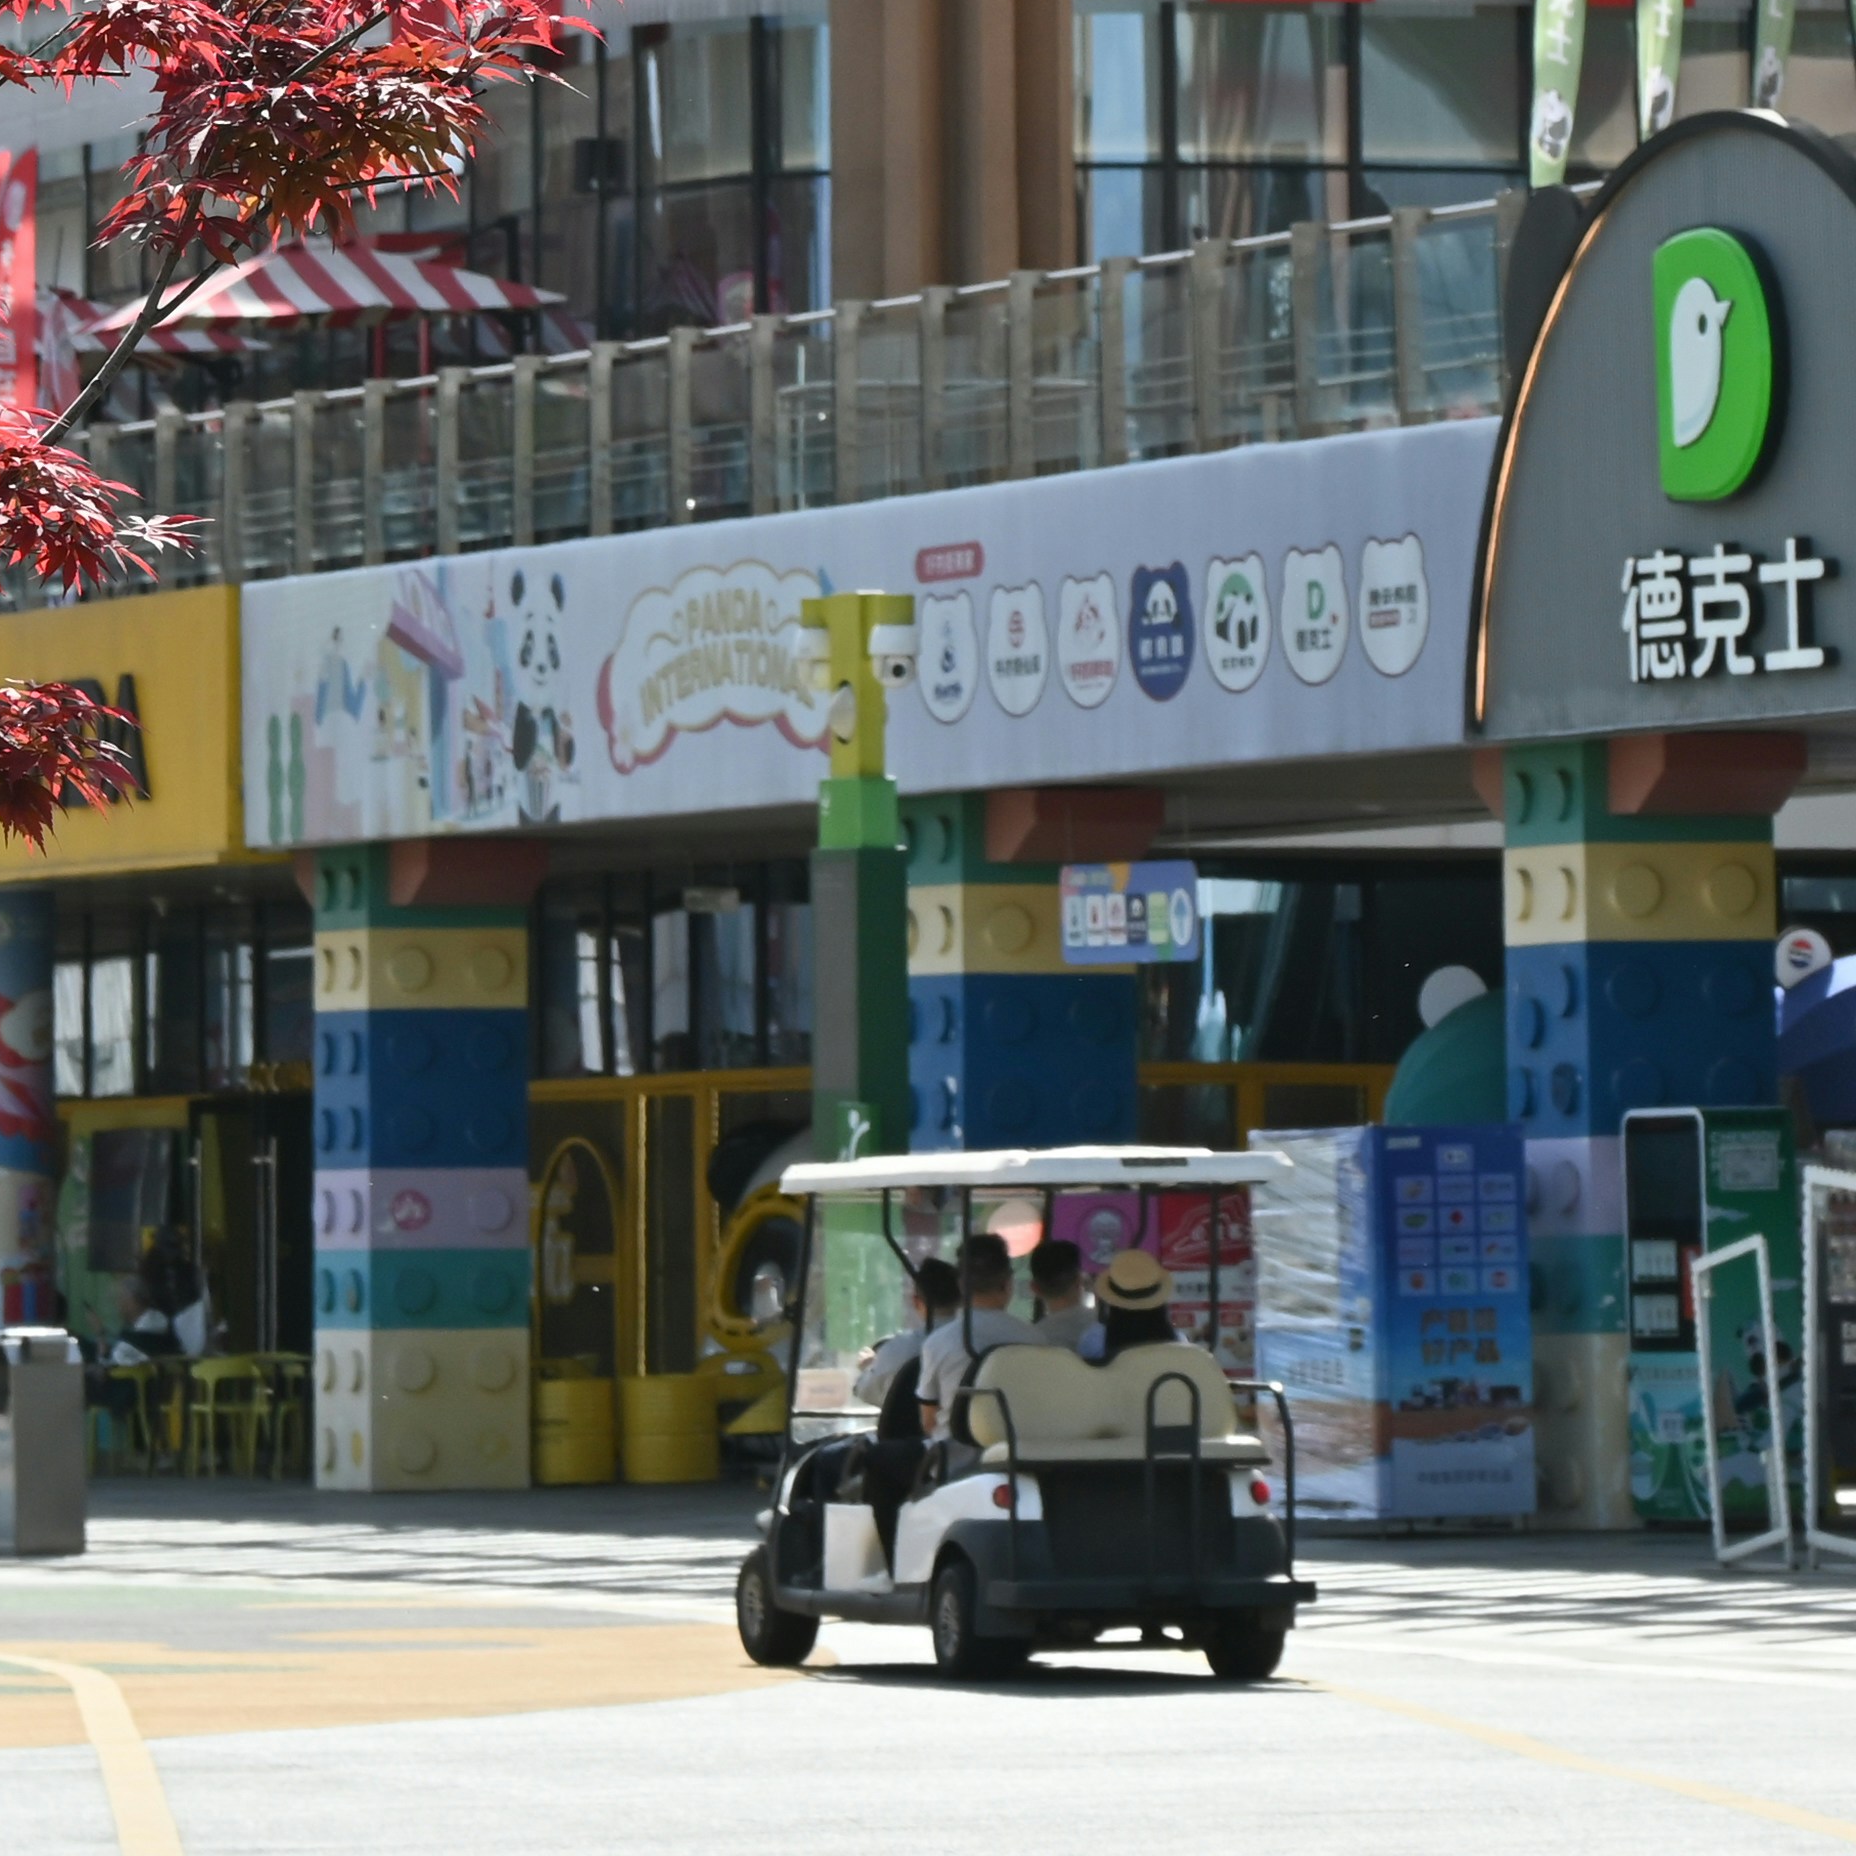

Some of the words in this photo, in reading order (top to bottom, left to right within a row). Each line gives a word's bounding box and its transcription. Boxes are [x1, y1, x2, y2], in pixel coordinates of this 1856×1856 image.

[686, 588, 763, 644] PANDA
[1621, 537, 1826, 684] 德克士
